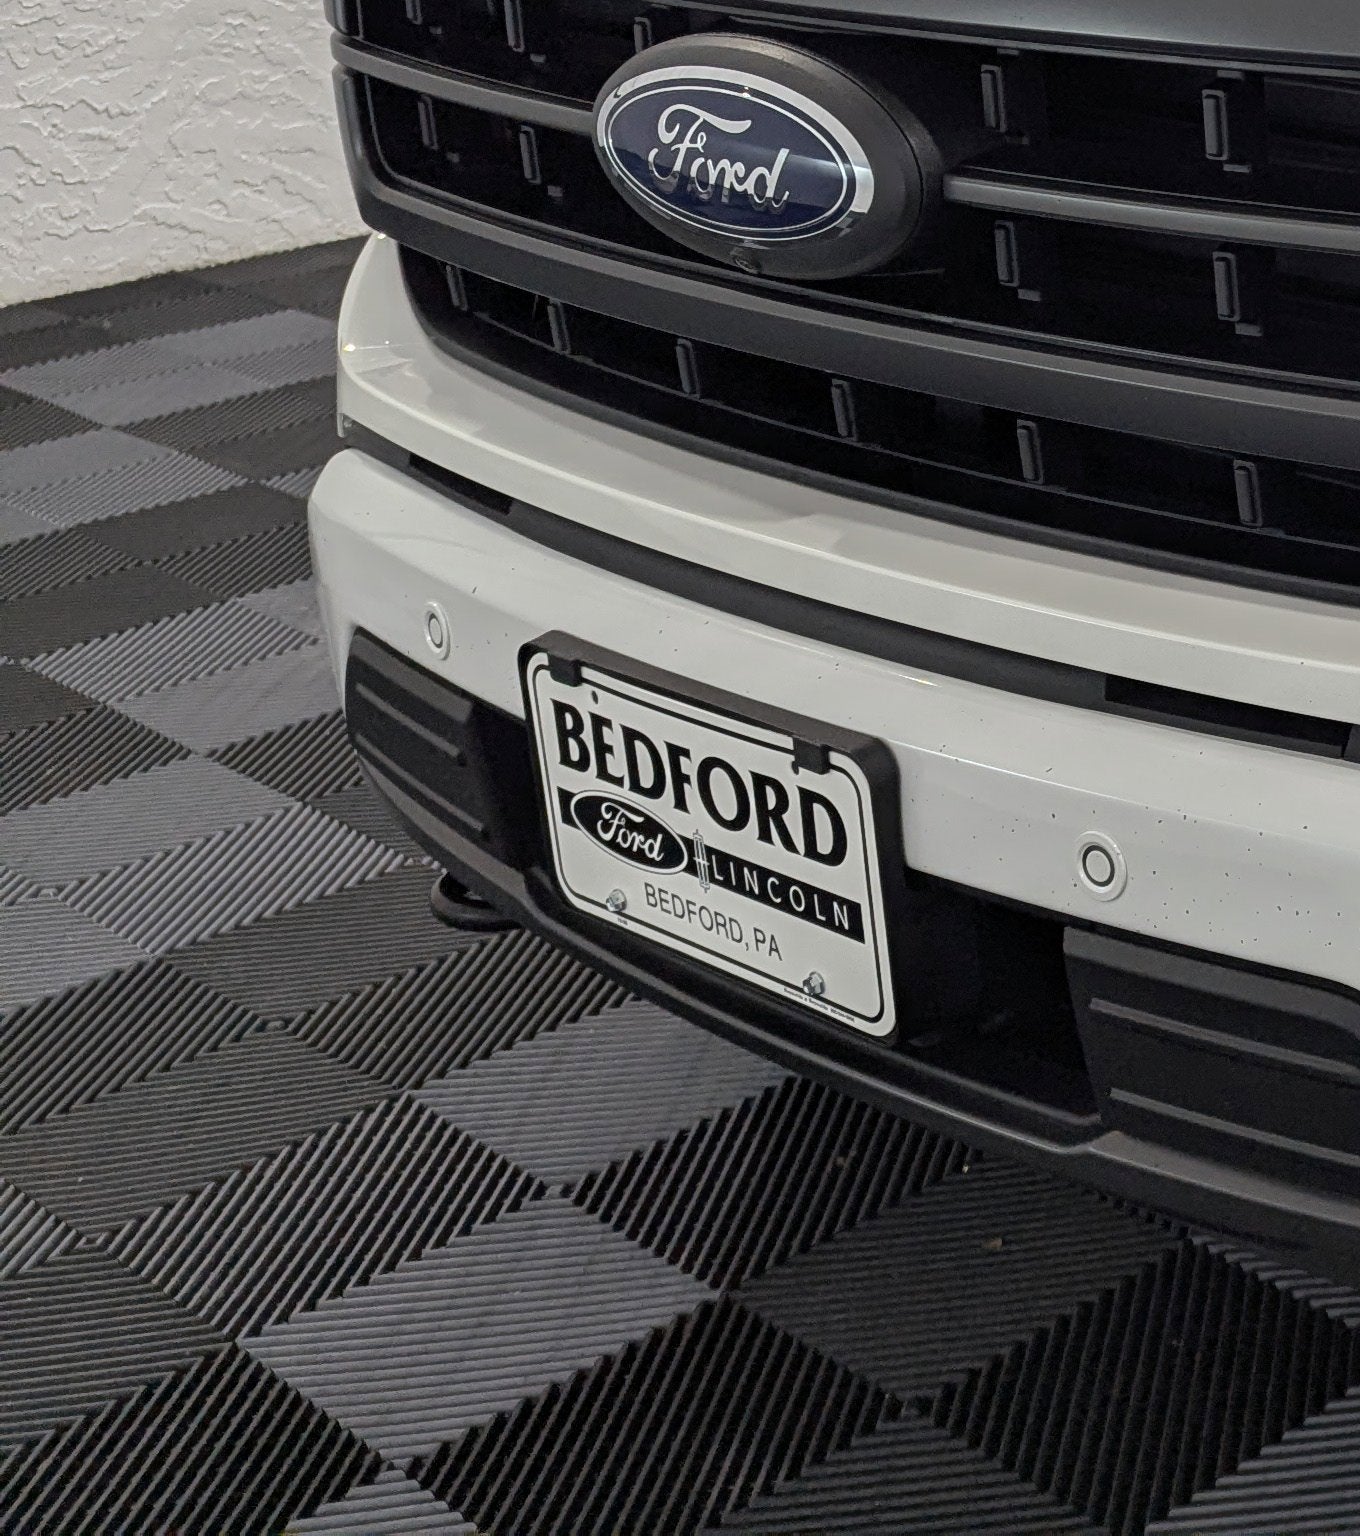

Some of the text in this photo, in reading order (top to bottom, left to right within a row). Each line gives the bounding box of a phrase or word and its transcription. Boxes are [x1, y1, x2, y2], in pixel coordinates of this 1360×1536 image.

[647, 103, 791, 208] Ford
[550, 696, 849, 868] BEDFORD
[597, 801, 665, 863] Ford
[712, 854, 850, 931] LINCOLN
